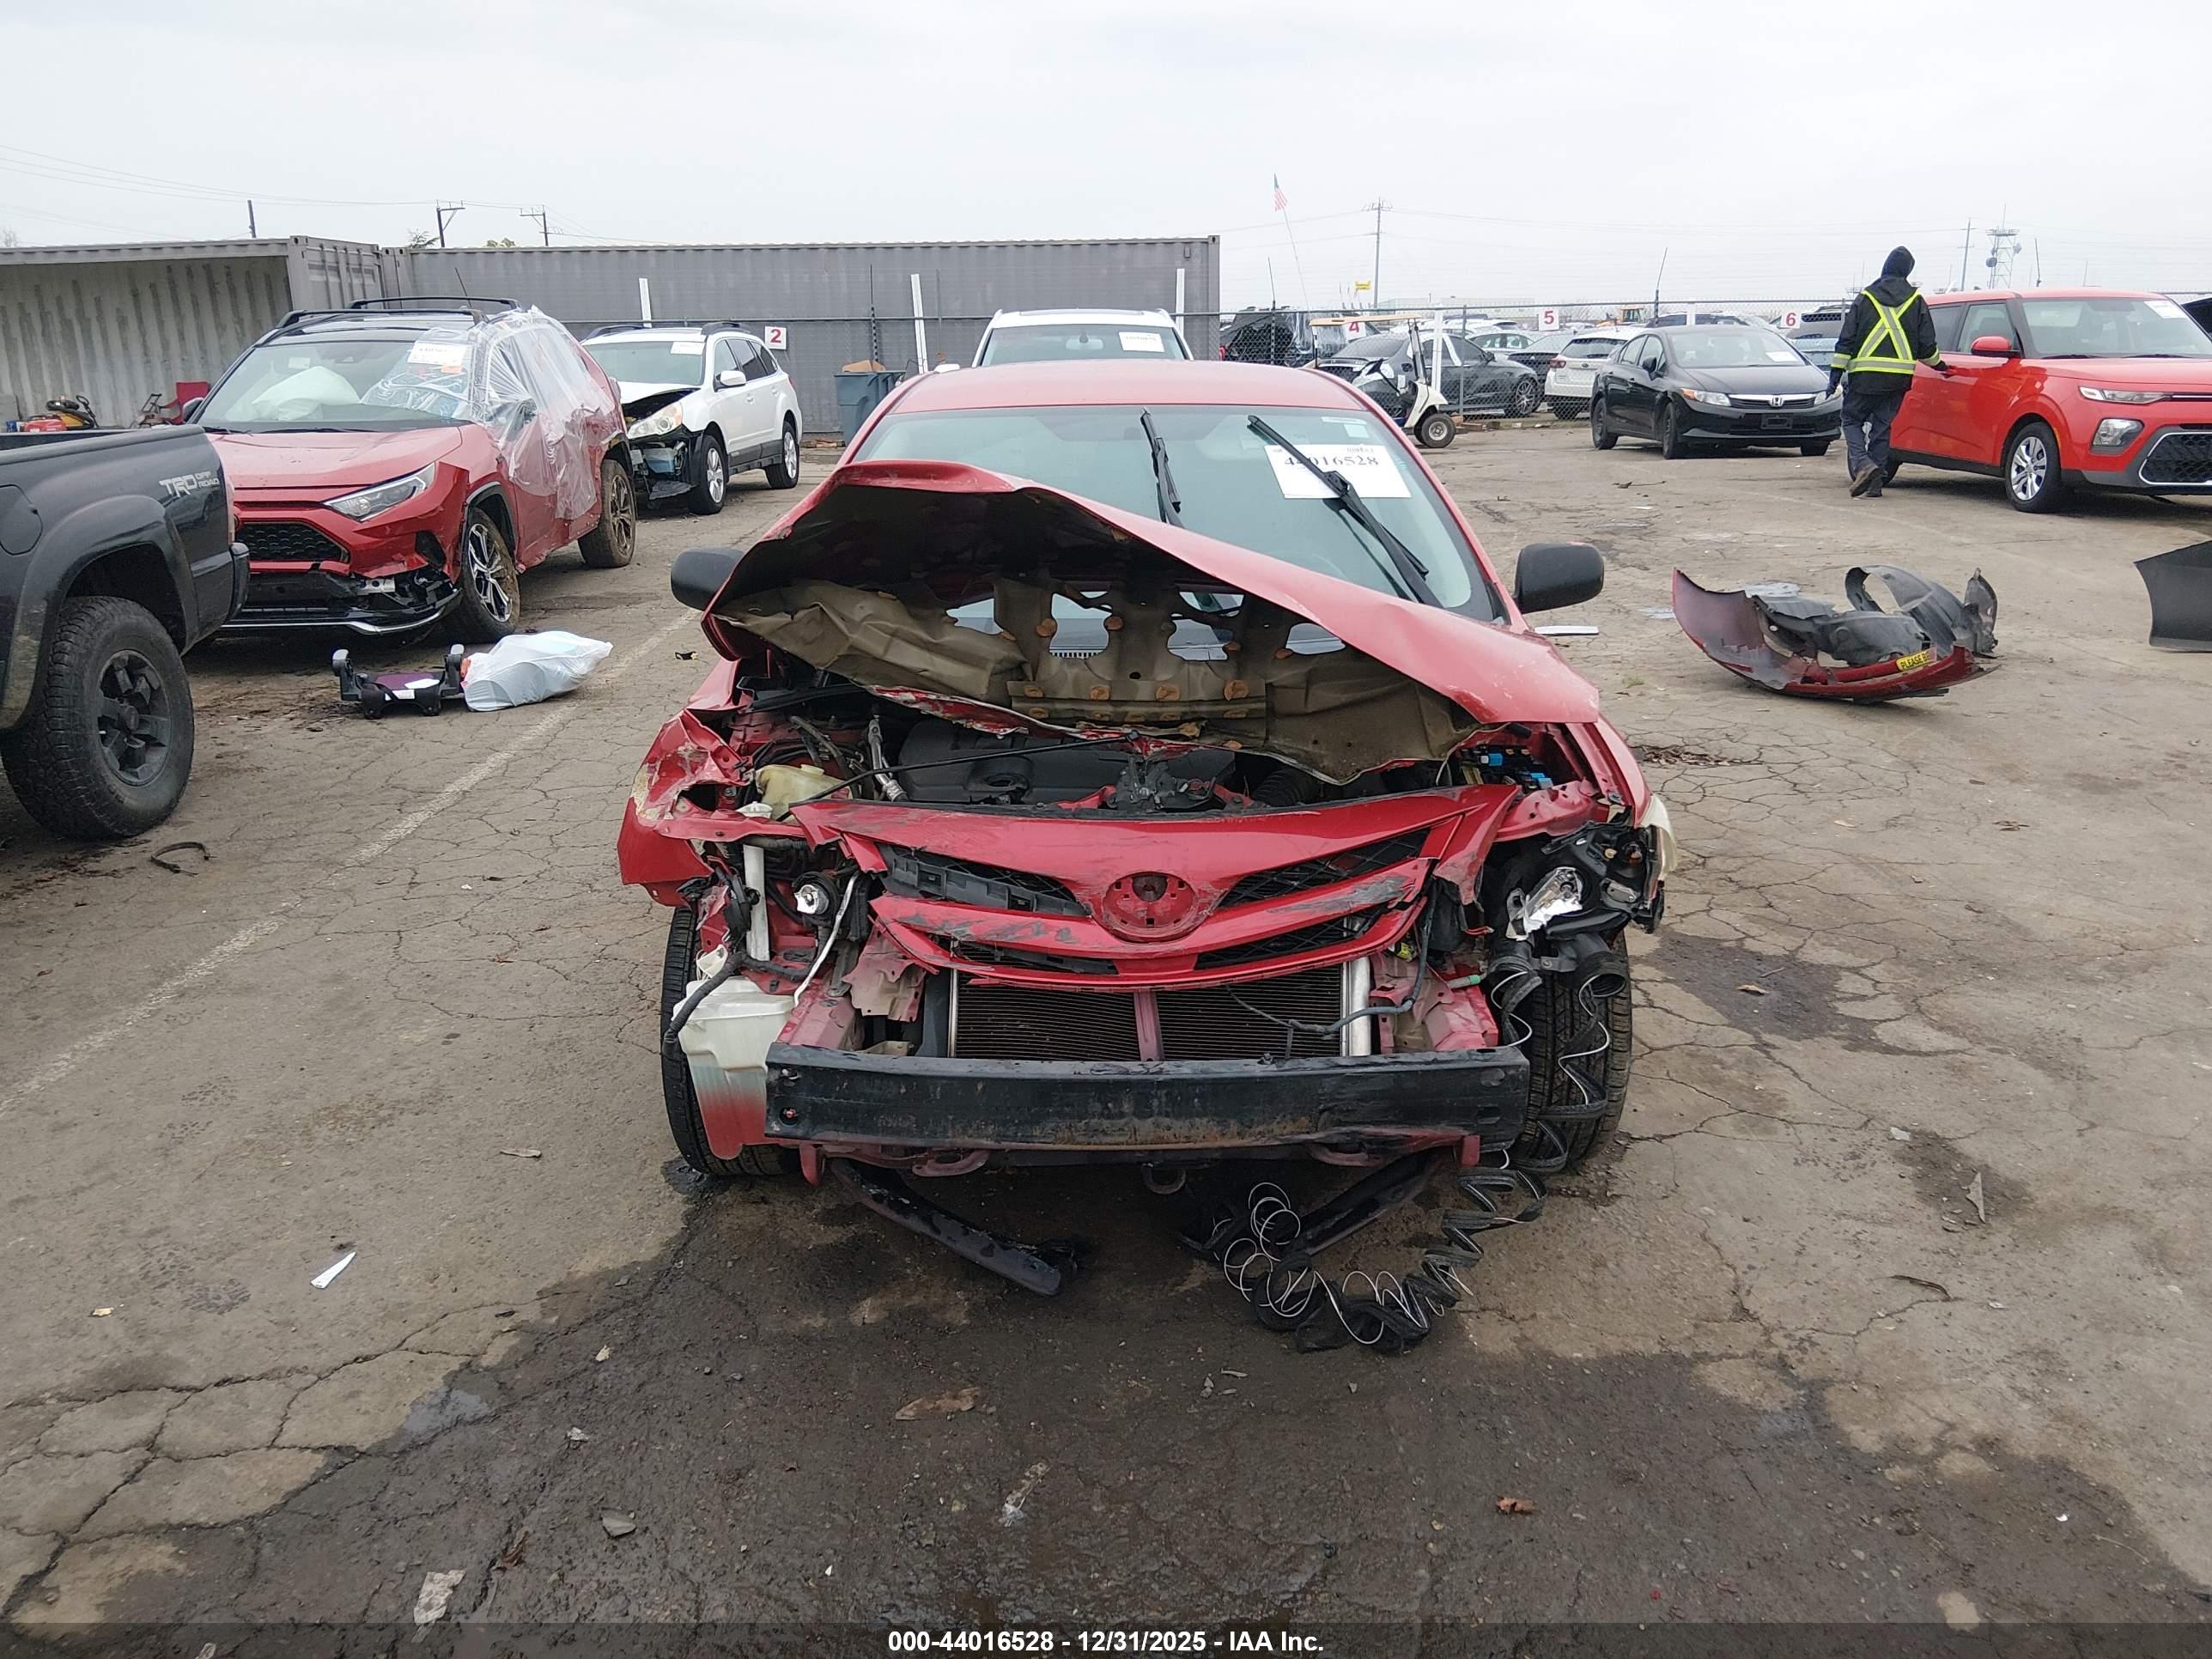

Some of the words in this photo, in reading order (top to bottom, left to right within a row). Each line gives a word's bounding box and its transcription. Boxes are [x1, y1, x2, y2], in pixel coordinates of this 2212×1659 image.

[1544, 310, 1554, 325] 5
[1786, 313, 1796, 326] 6
[1349, 321, 1359, 332] 4
[770, 329, 781, 343] 2
[159, 474, 198, 497] TRD
[198, 477, 220, 488] ROAD
[1899, 654, 1923, 669] PLEASE
